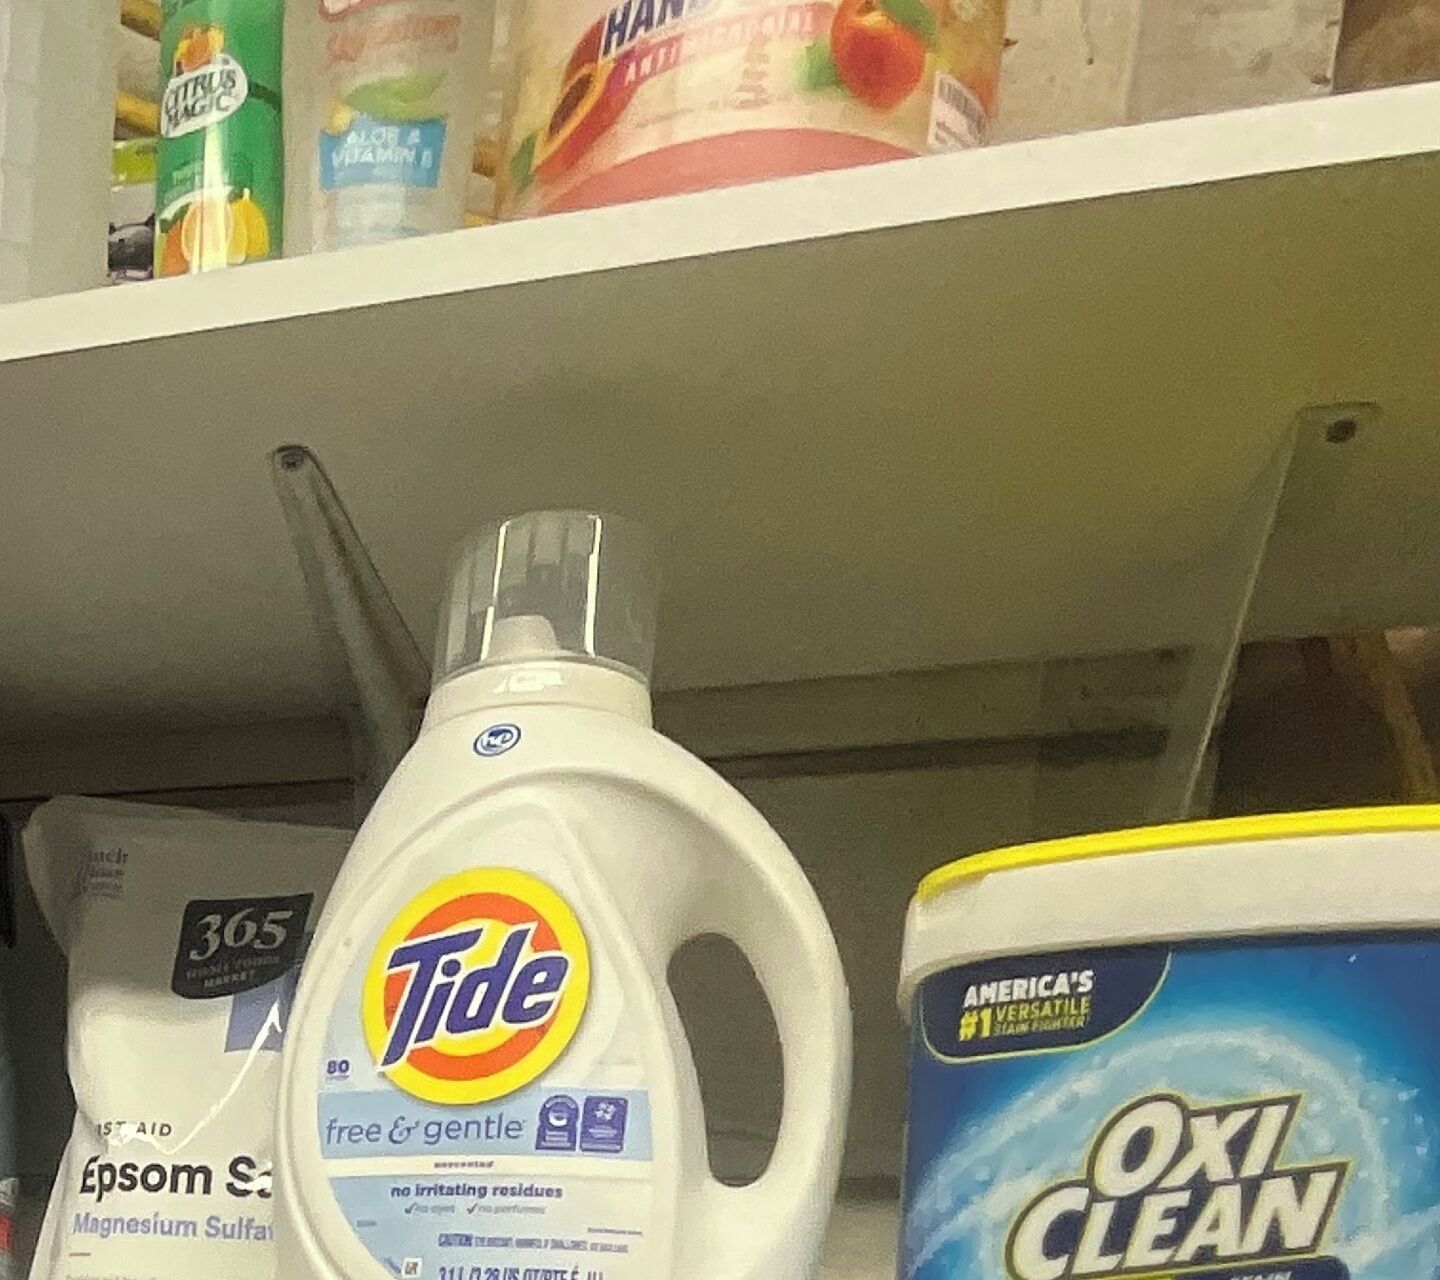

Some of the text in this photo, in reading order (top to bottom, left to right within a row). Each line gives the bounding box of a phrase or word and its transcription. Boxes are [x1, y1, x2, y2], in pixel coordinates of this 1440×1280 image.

[603, 0, 688, 58] HAN
[189, 907, 294, 961] 365
[380, 922, 570, 1072] Tide
[963, 969, 1095, 1009] AMERICA'S
[959, 997, 1091, 1041] #1 VERSATILE
[136, 1121, 173, 1138] AID
[326, 1117, 382, 1146] free
[388, 1115, 421, 1144] &
[423, 1111, 526, 1147] gentle
[1092, 1098, 1292, 1198] OXI
[80, 1154, 214, 1203] Epsom
[390, 1183, 564, 1199] no irritating residues
[73, 1212, 198, 1239] Magnesium
